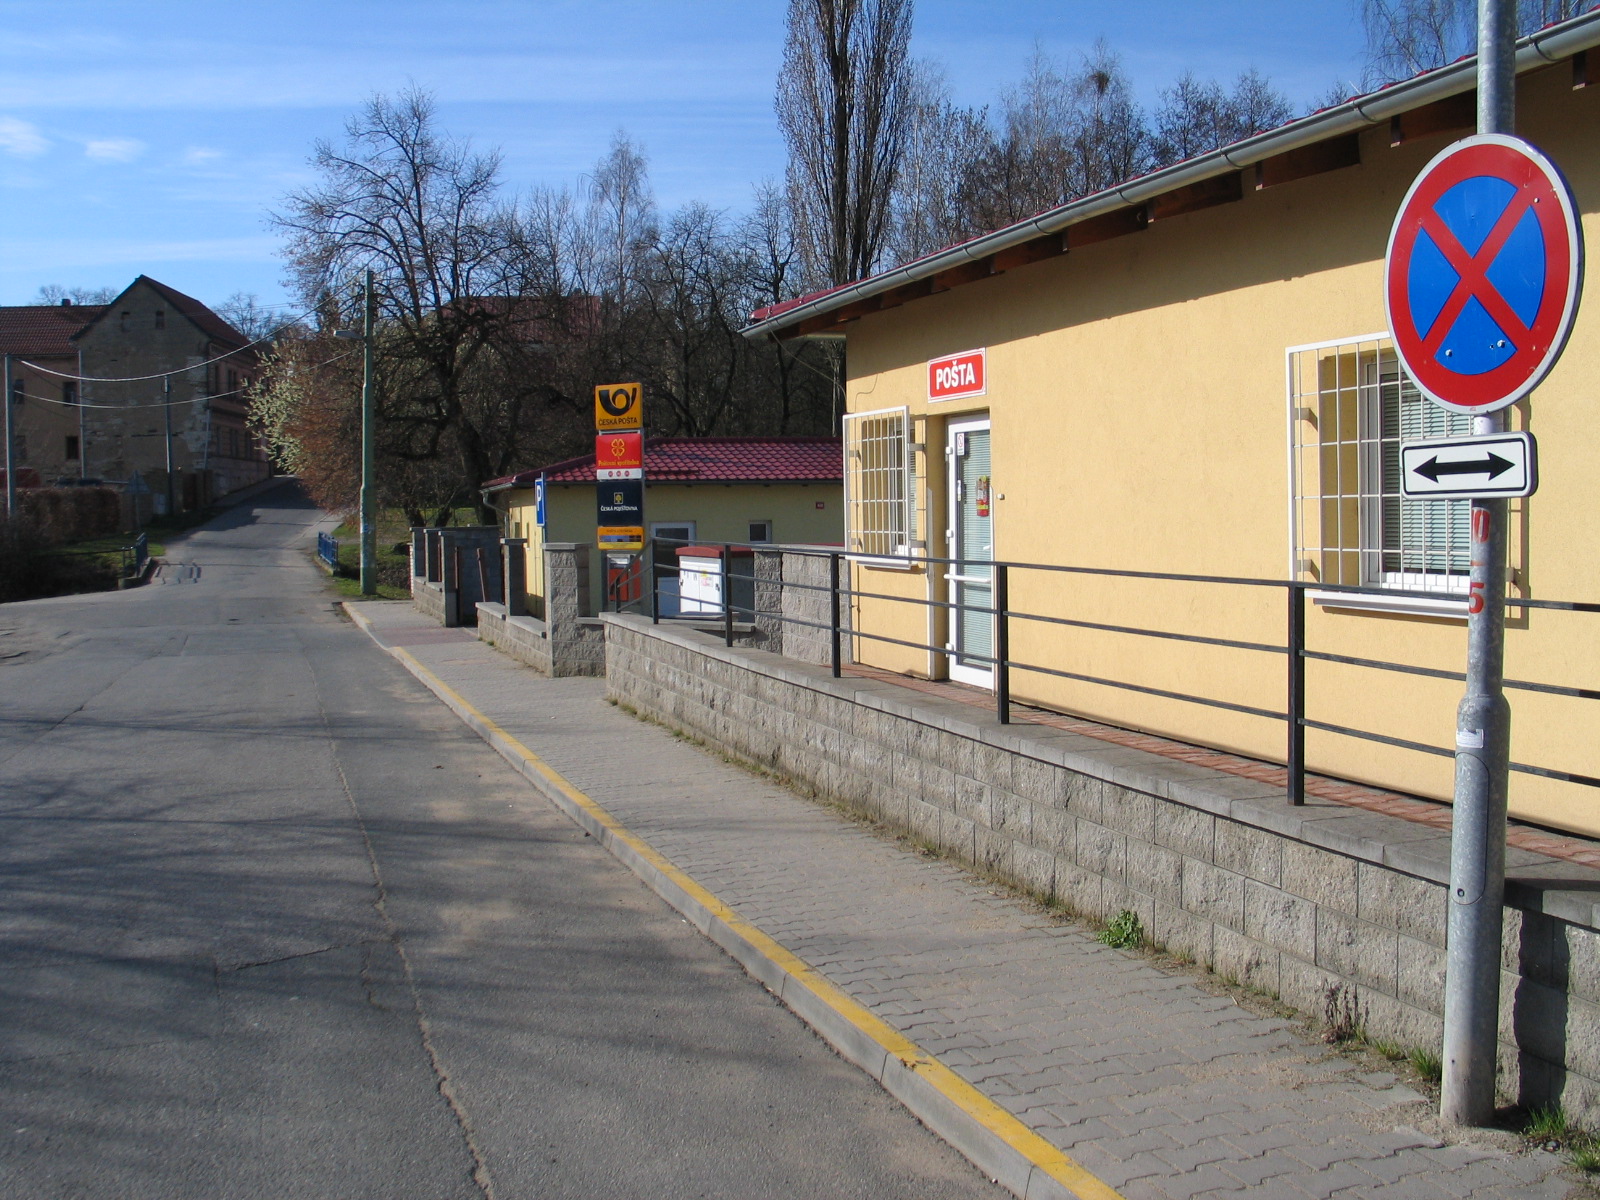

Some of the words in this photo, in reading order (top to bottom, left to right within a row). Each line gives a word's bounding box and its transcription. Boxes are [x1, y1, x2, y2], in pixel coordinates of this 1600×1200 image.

[935, 360, 976, 390] POŠTA
[618, 416, 638, 425] POŠTA
[536, 484, 542, 512] P
[1469, 581, 1485, 614] 5
